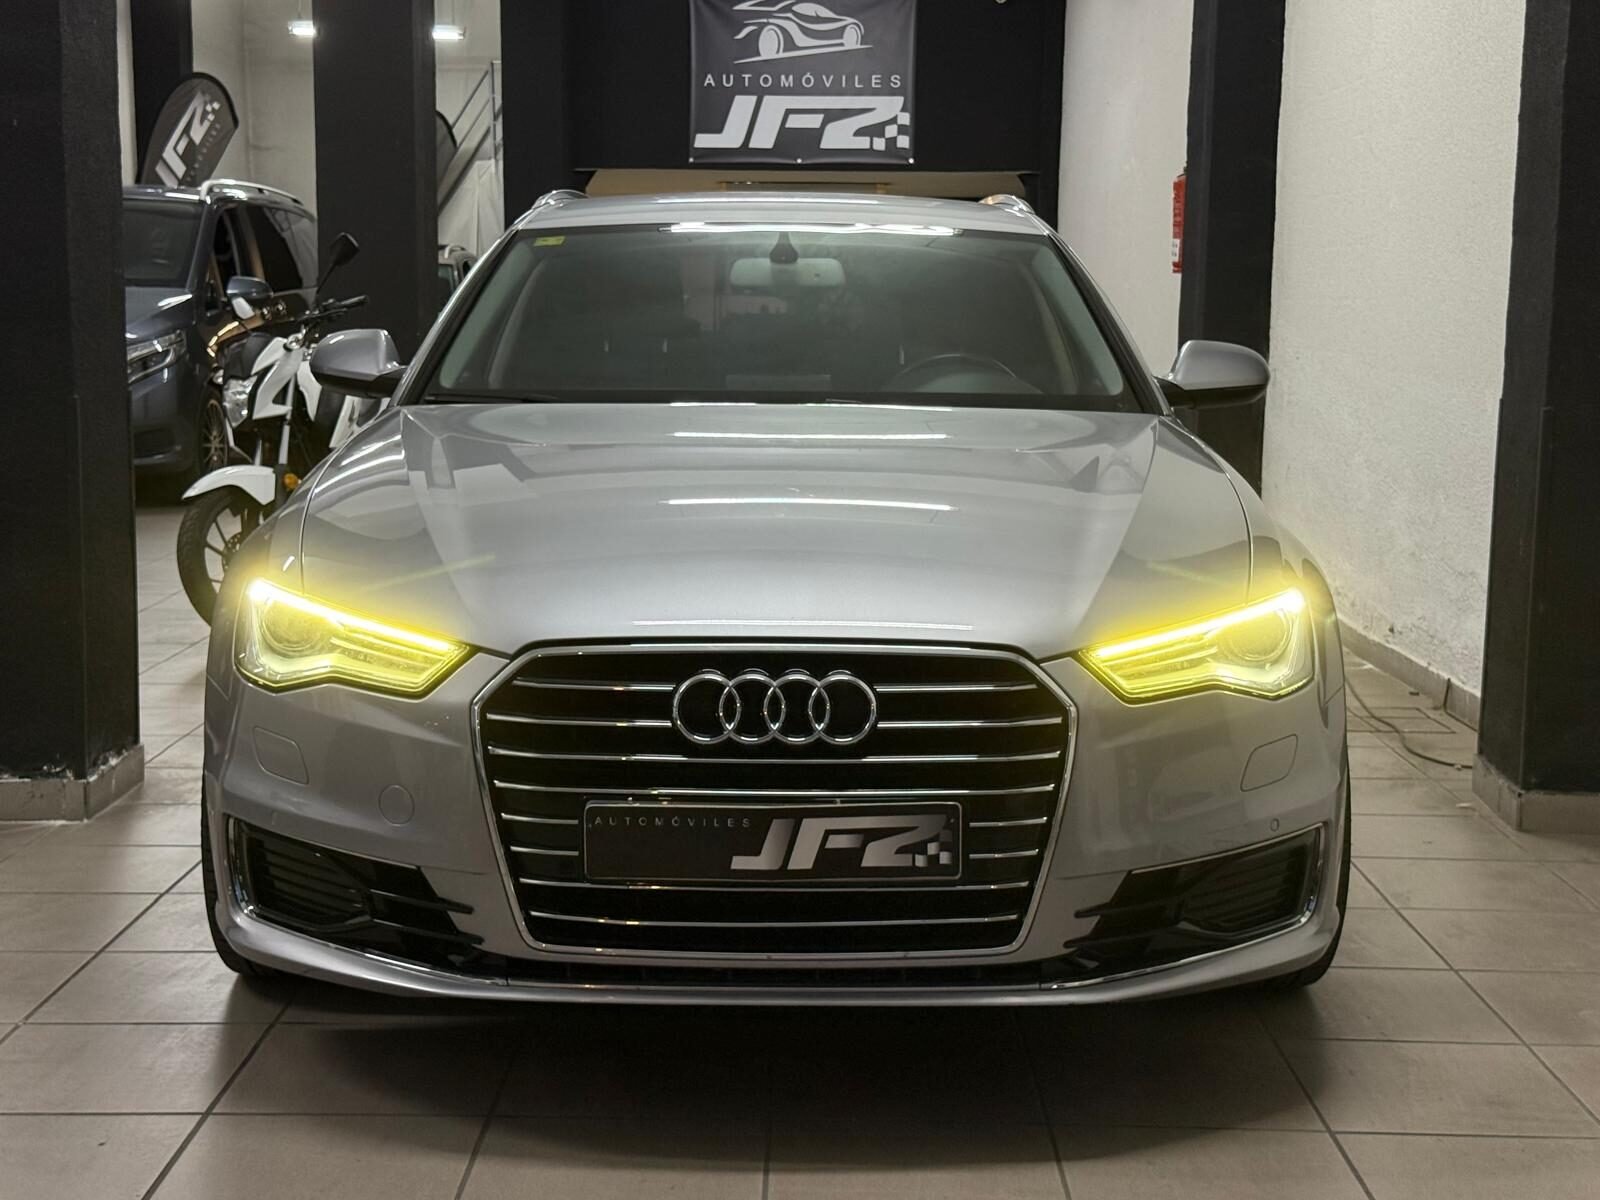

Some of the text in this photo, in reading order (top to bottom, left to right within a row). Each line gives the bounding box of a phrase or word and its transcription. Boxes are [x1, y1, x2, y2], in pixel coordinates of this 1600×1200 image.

[703, 72, 902, 89] AUTOMÓVILES
[693, 94, 906, 150] JFZ
[593, 814, 752, 829] AUTOMÓVILES
[730, 814, 948, 871] JFZ
